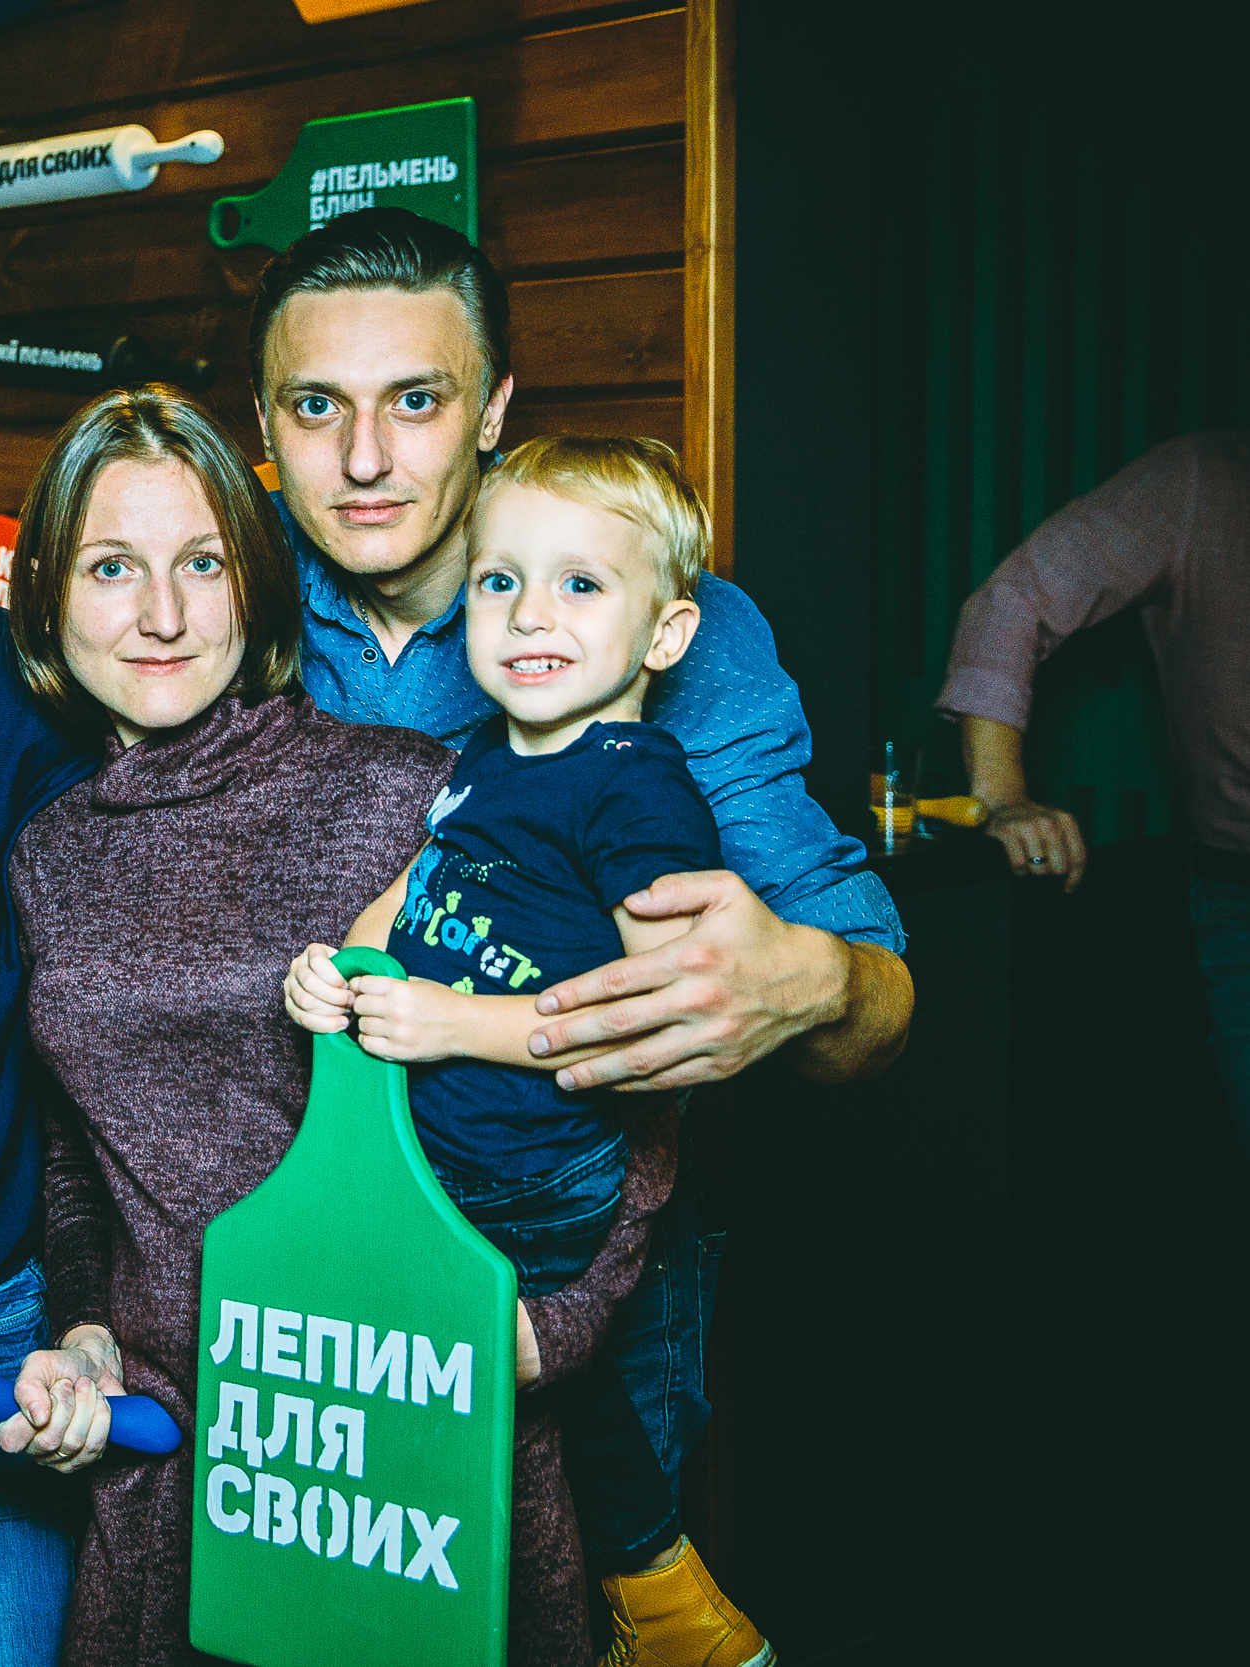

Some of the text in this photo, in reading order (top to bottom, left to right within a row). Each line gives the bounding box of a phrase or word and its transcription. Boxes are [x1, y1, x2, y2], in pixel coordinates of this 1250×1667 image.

[40, 142, 113, 175] СВОИХ
[309, 155, 458, 194] #ПЕЛЬМЕНЬ
[209, 1299, 473, 1414] ЛЕПИМ
[207, 1381, 365, 1478] ДЛЯ
[206, 1463, 460, 1590] СВОИХ
